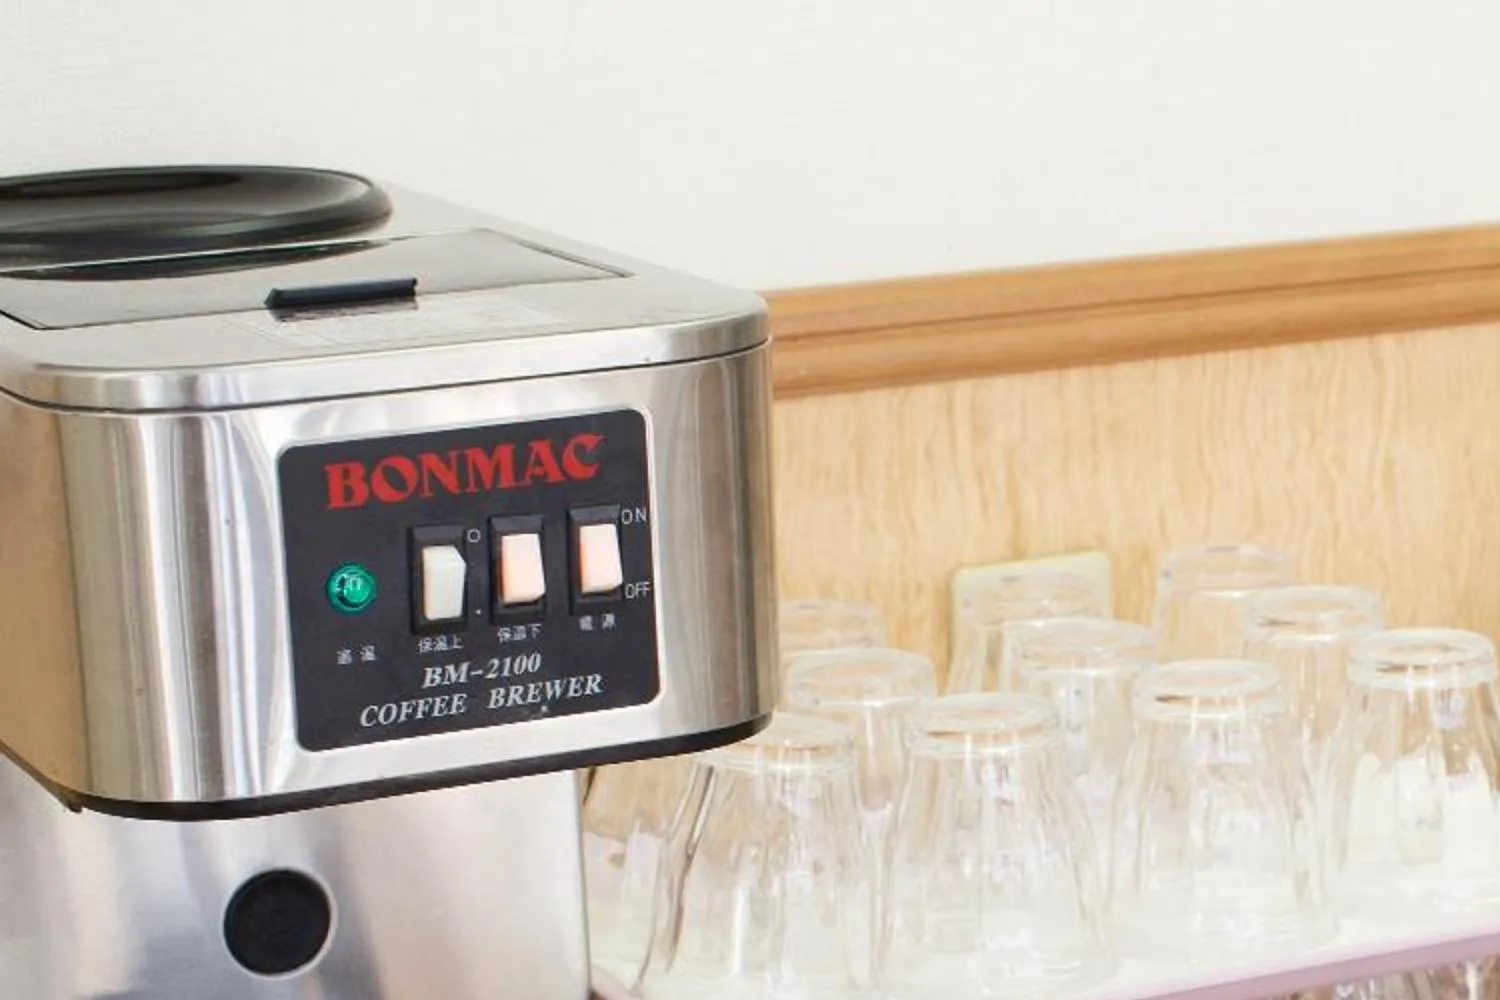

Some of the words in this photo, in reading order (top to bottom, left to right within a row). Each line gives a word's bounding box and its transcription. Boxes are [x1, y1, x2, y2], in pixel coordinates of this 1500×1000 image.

[325, 433, 606, 509] BONMAC
[621, 507, 647, 525] ON
[625, 581, 651, 599] OFF
[422, 653, 543, 689] BM-2100
[360, 693, 467, 728] COFFEE
[487, 673, 604, 709] BREWER
